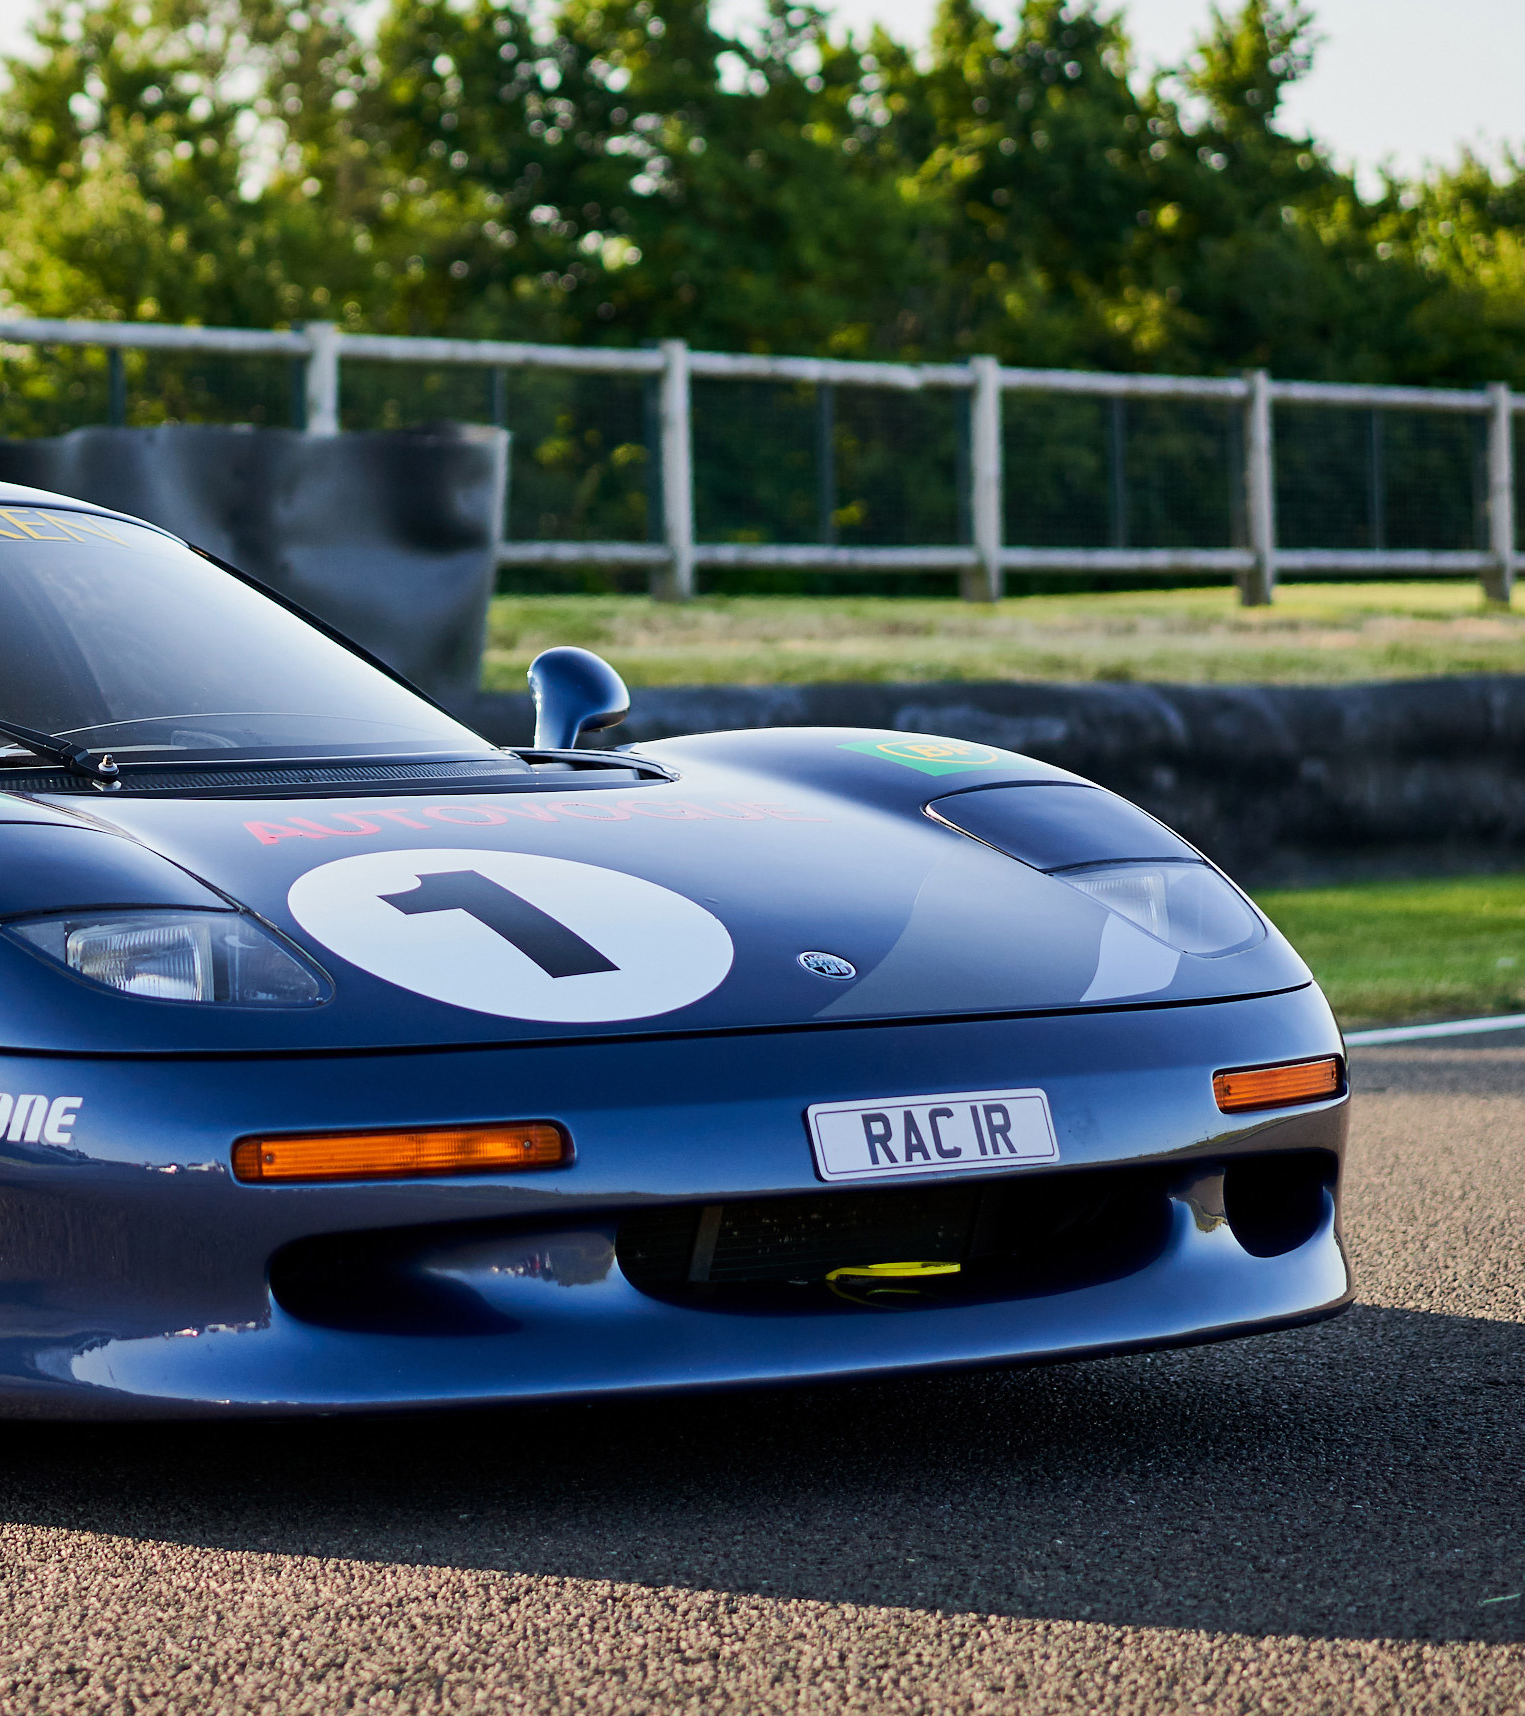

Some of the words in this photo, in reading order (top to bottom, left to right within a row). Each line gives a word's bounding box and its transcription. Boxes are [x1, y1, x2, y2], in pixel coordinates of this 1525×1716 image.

[904, 743, 972, 758] BP
[241, 799, 833, 846] AUTOVOGUE
[376, 869, 621, 979] 1
[860, 1106, 963, 1166] RAC
